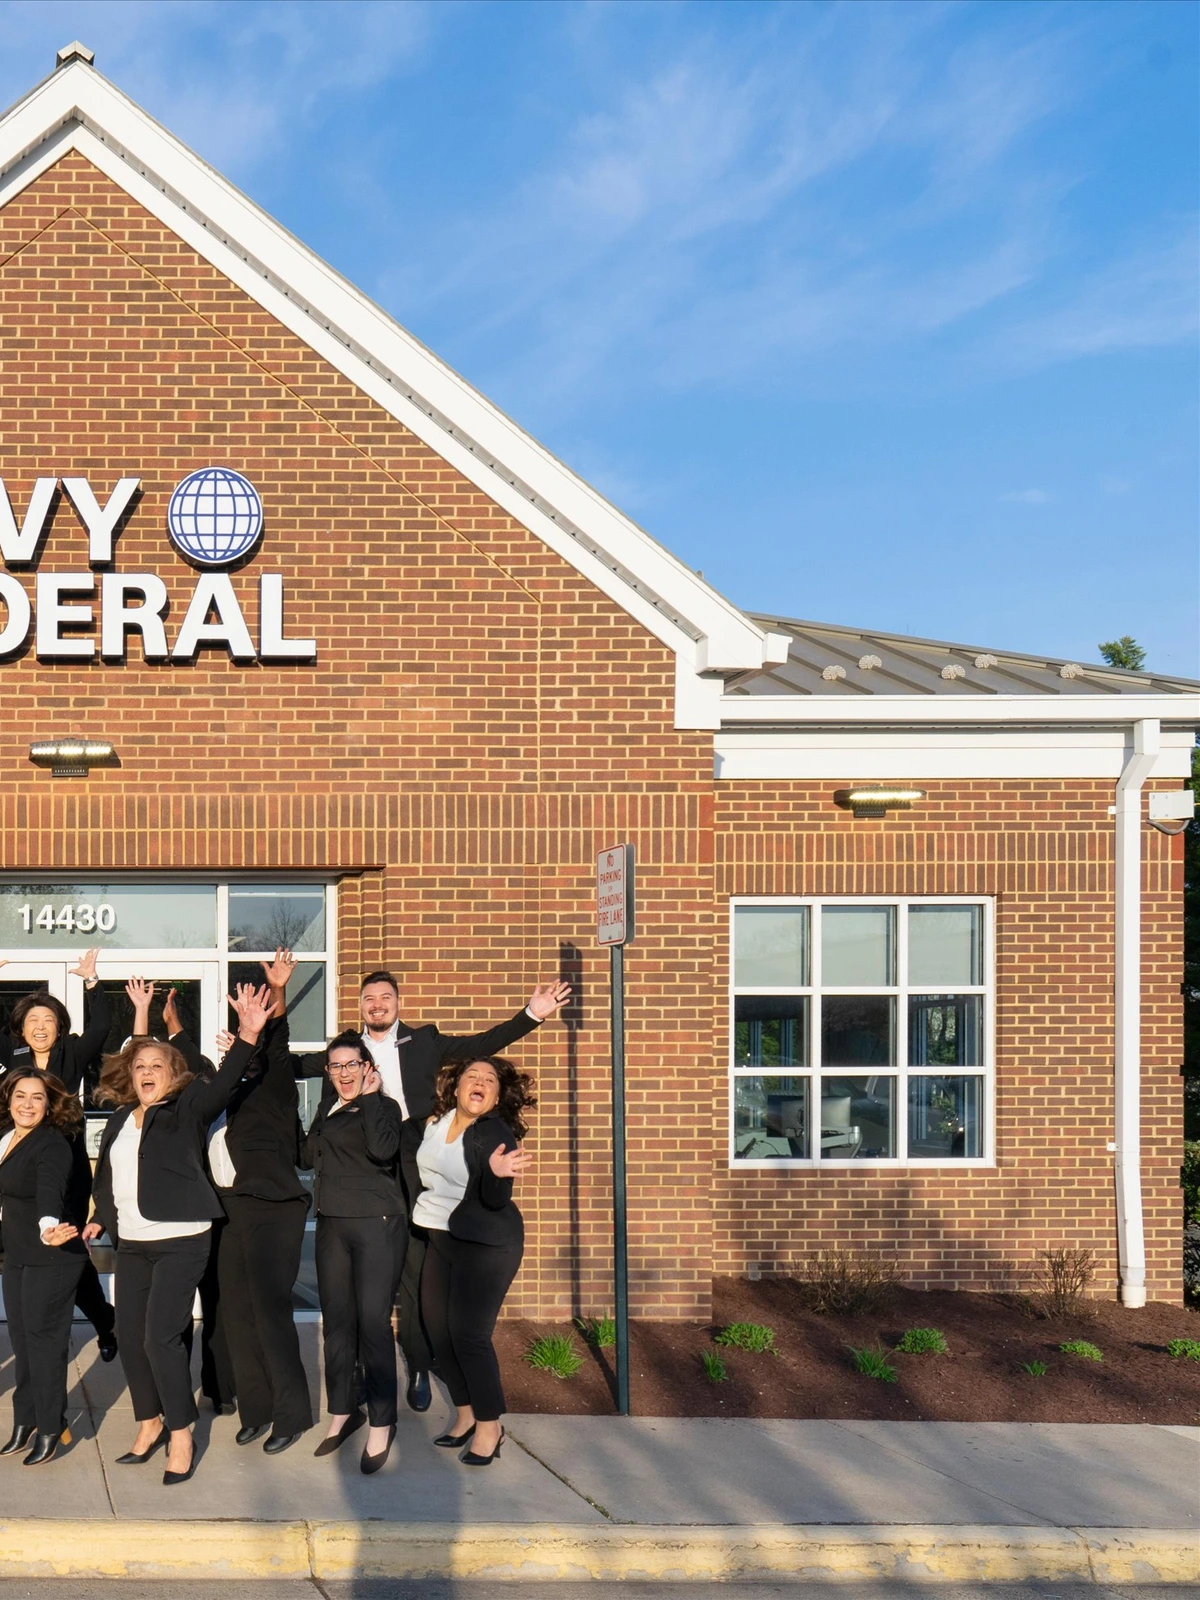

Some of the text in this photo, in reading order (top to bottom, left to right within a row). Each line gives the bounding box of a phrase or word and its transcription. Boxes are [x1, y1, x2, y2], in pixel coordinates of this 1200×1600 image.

[607, 855, 615, 868] NO
[600, 869, 622, 886] PARKING
[599, 893, 623, 909] STANDING
[18, 904, 115, 930] 14430
[599, 908, 623, 926] FIRE LANE
